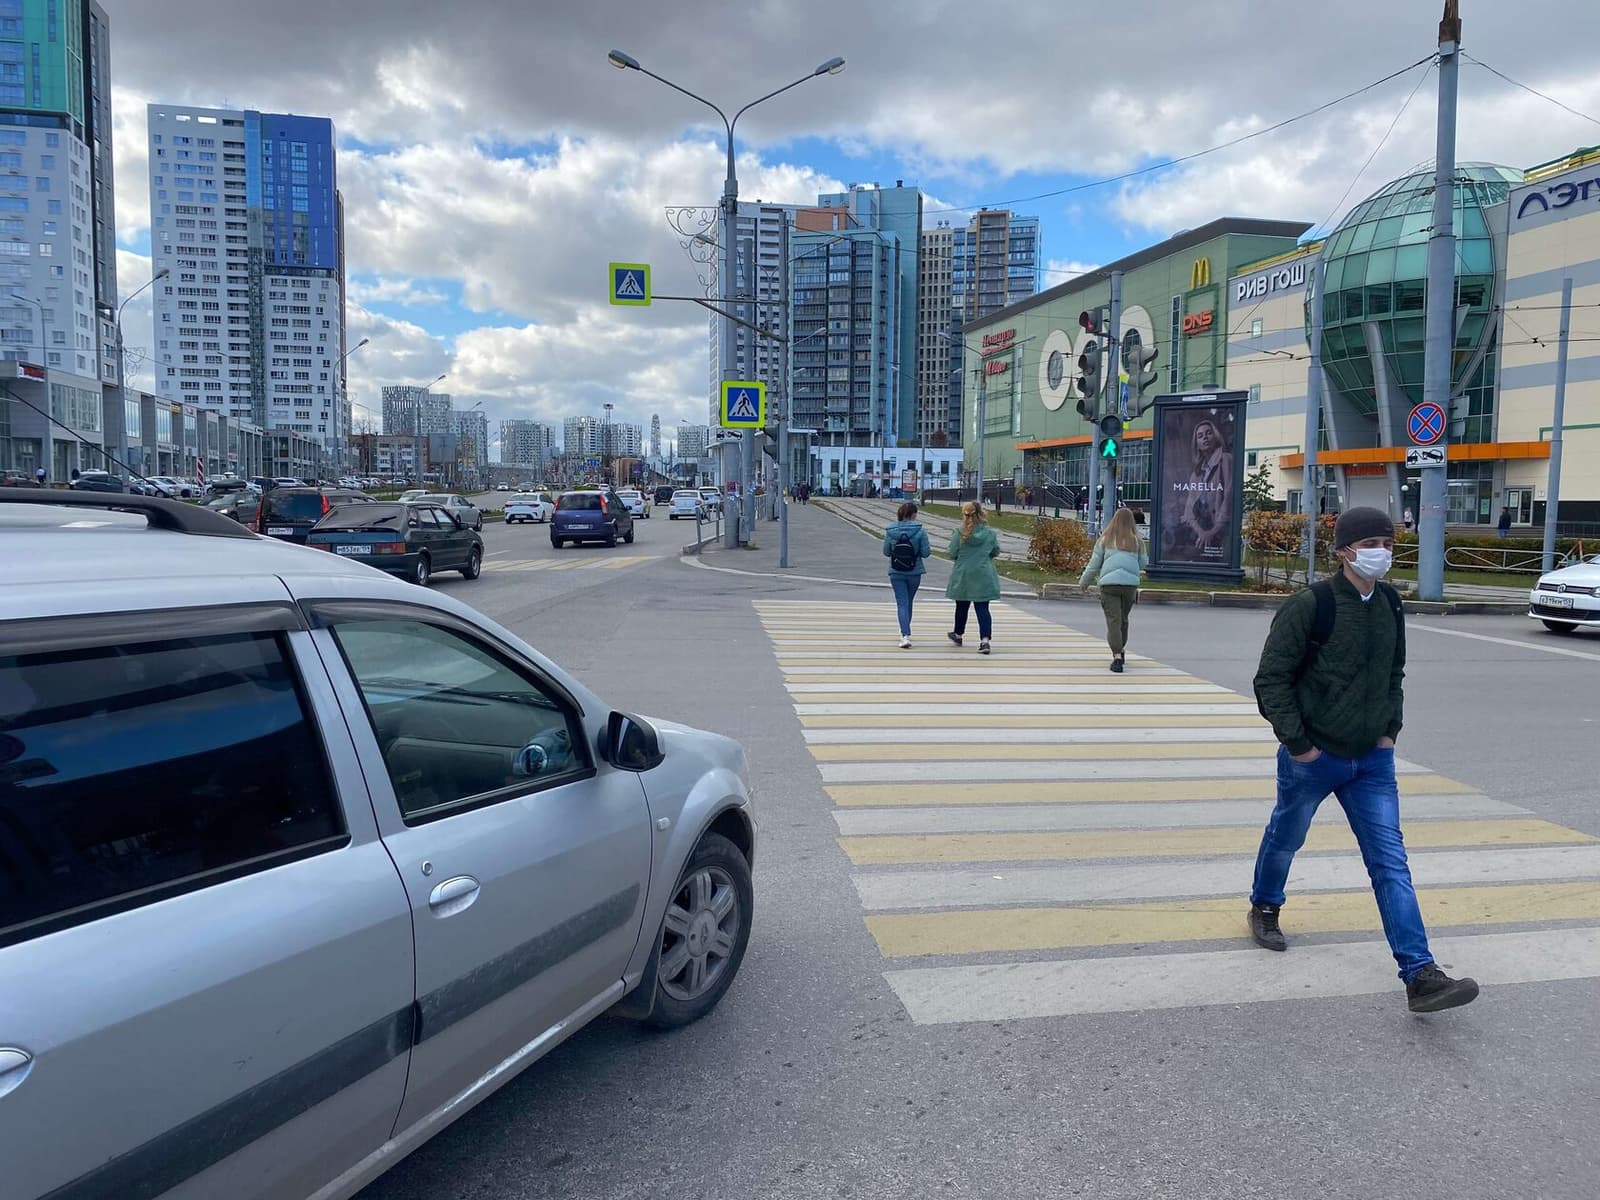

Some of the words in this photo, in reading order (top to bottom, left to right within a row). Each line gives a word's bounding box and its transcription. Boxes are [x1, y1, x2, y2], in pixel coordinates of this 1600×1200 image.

[1237, 275, 1268, 302] РИВ
[1271, 264, 1306, 292] ГОШ
[1183, 307, 1213, 332] DNS
[1173, 482, 1224, 491] MARELLA
